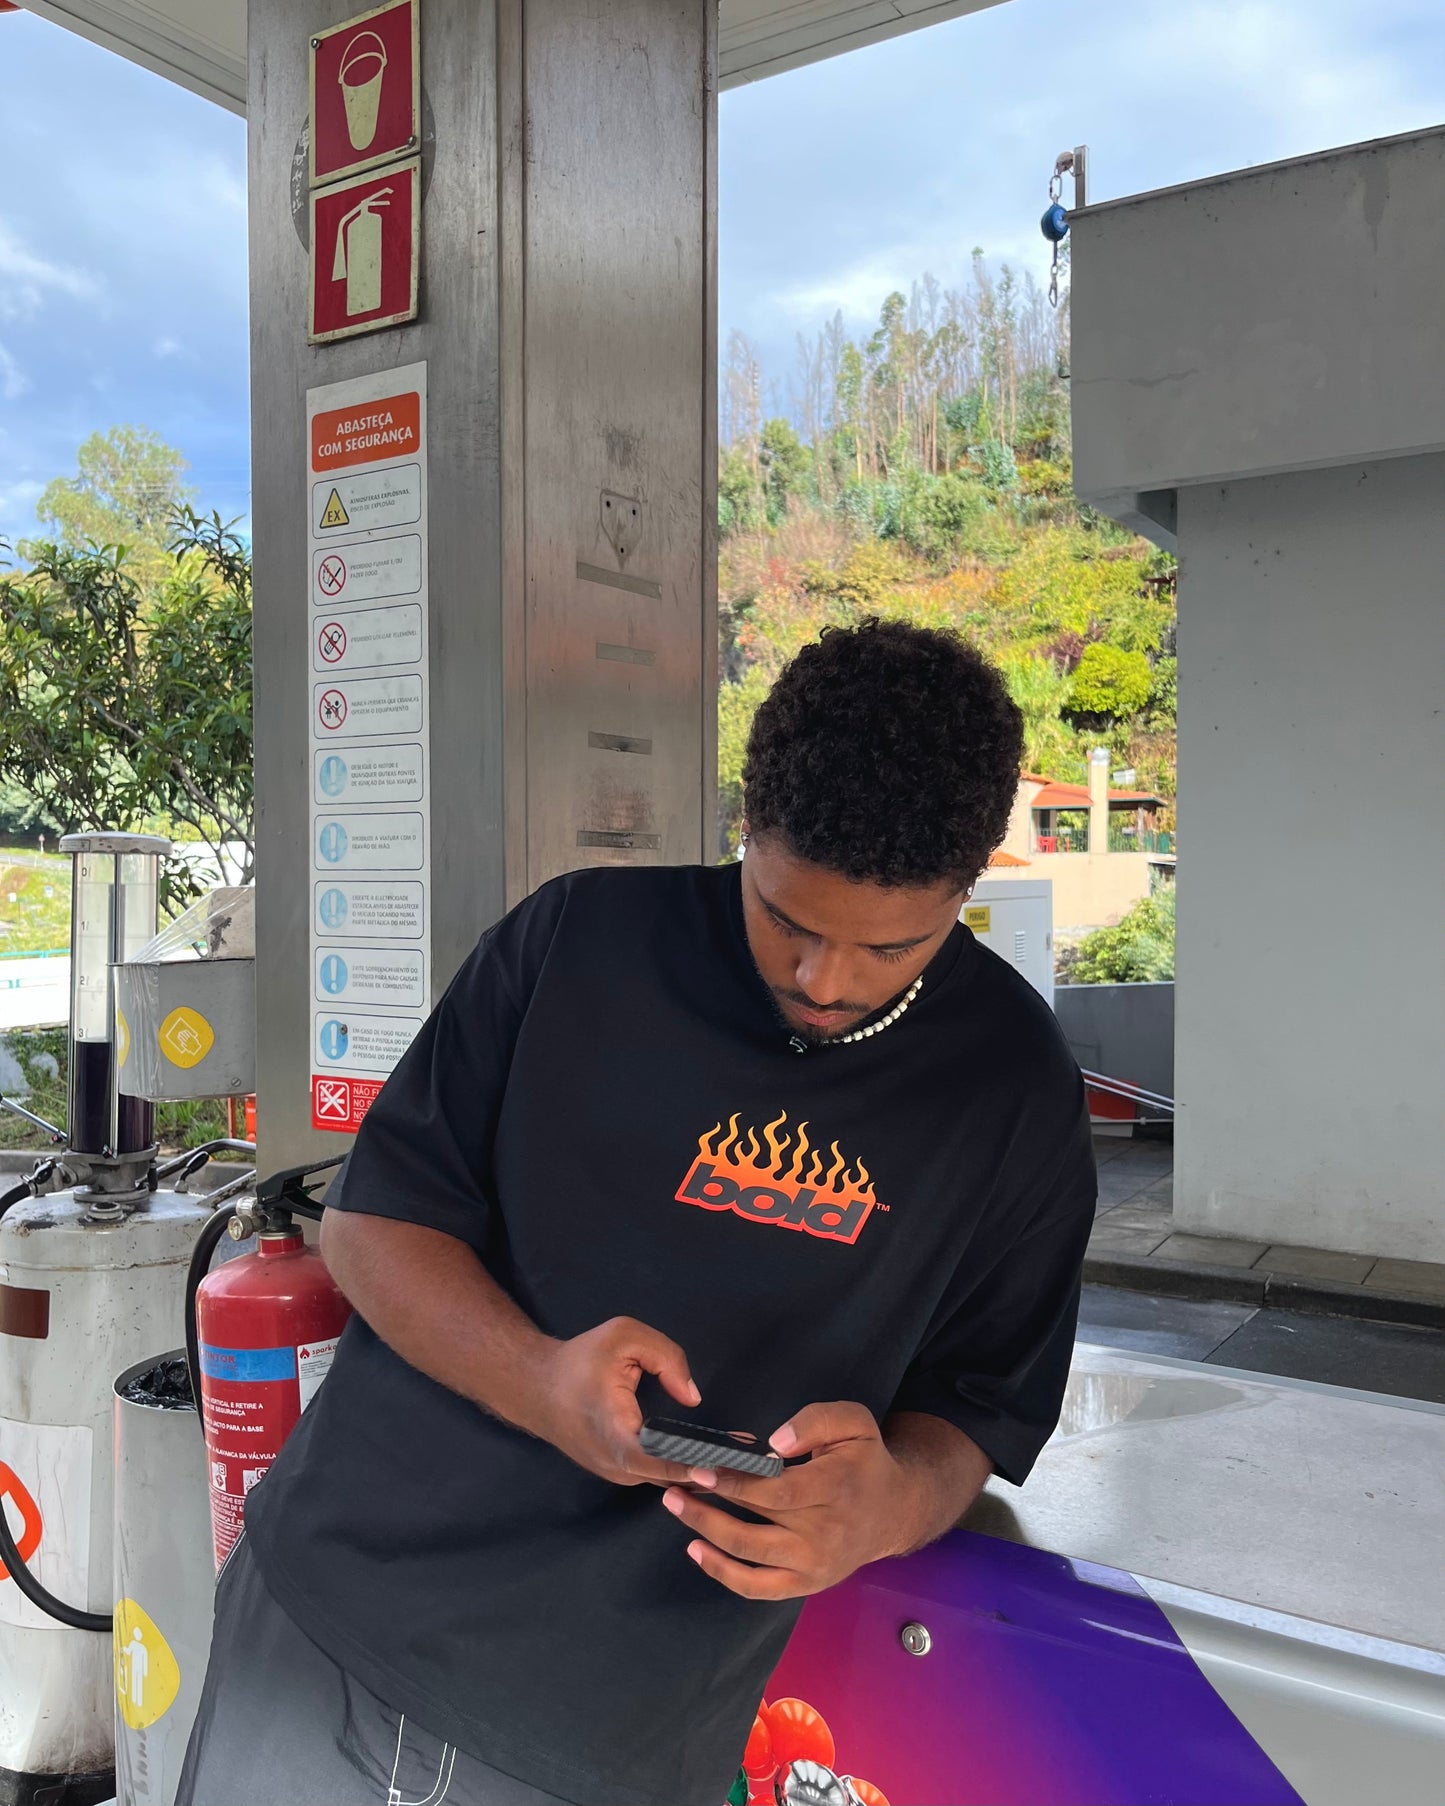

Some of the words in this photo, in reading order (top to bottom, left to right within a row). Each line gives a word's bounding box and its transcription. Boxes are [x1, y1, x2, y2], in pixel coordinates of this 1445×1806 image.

[336, 412, 393, 435] ABASTEÇA
[318, 442, 342, 457] COM
[345, 426, 413, 452] SEGURANÇA
[327, 510, 341, 523] EX
[353, 1086, 370, 1096] NÃO
[353, 1098, 365, 1107] NO
[679, 1160, 871, 1241] bold
[248, 1451, 276, 1459] VÁLVULA
